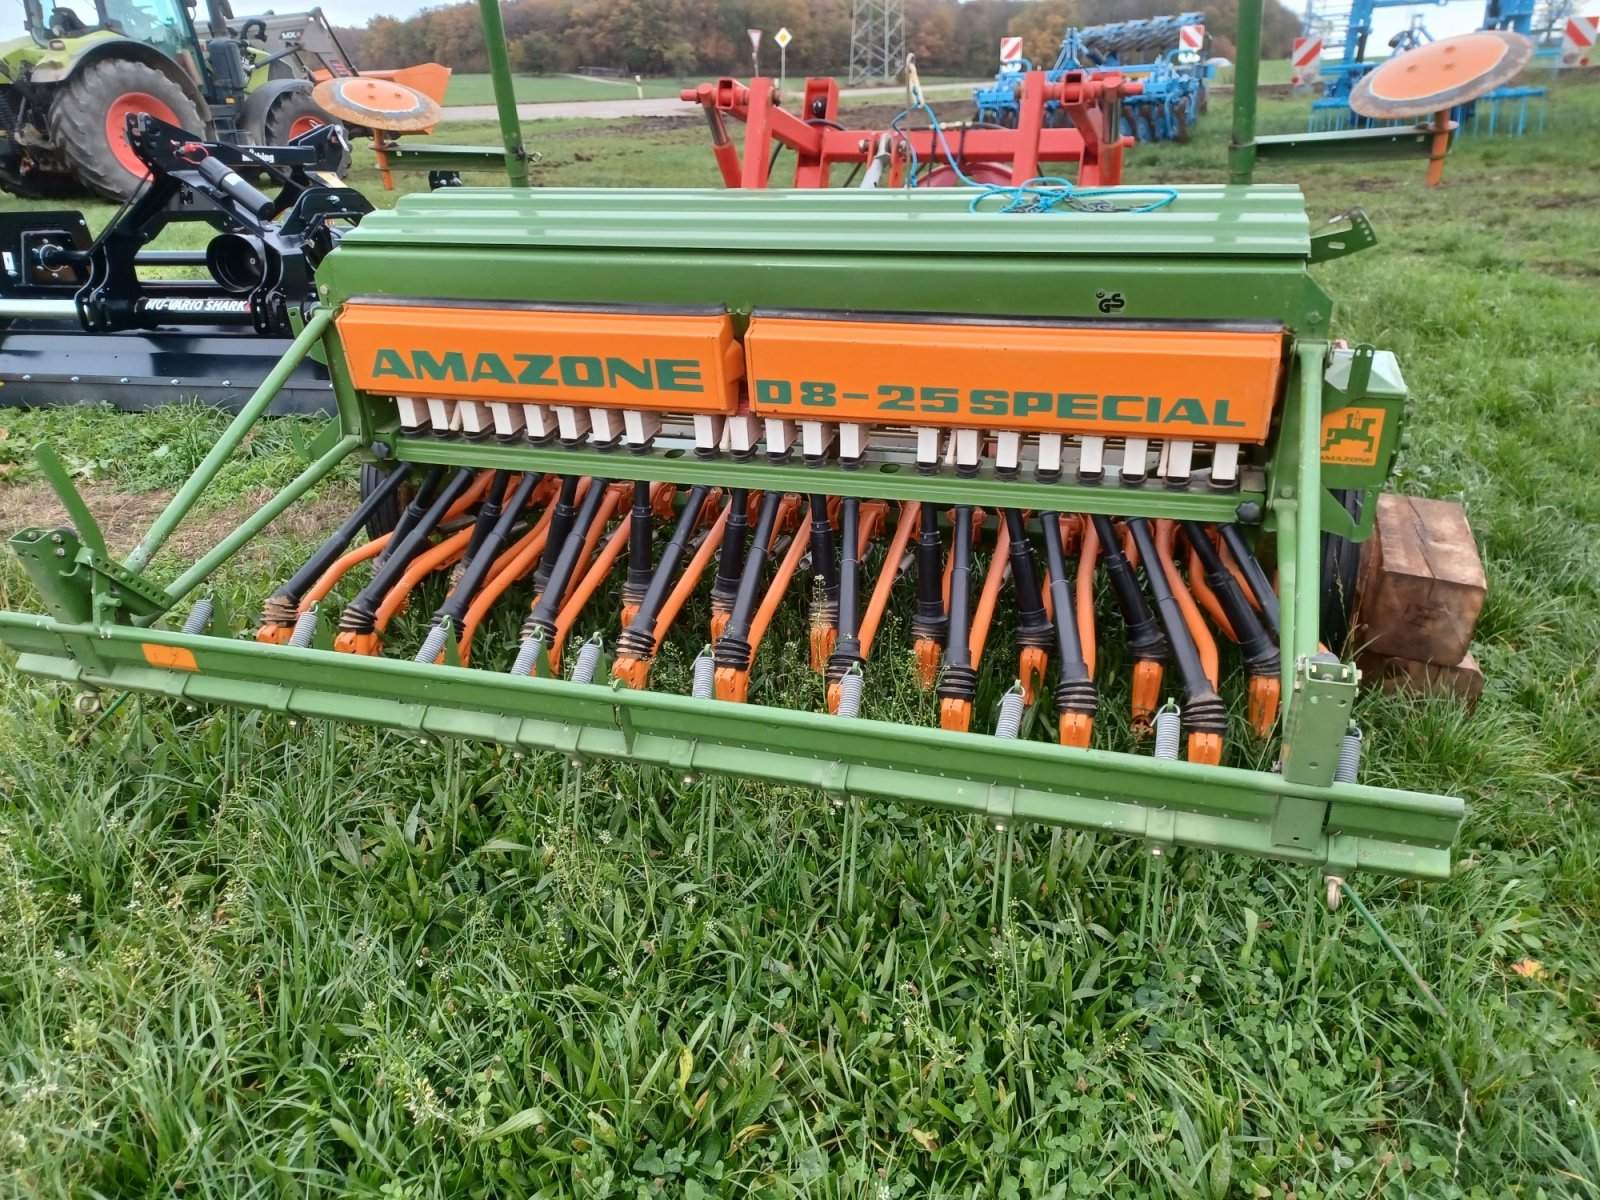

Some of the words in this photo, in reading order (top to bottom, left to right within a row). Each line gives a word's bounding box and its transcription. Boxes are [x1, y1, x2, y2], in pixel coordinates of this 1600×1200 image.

[204, 300, 249, 311] SHARK
[372, 348, 705, 393] AMAZONE
[968, 389, 1247, 428] SPECIAL
